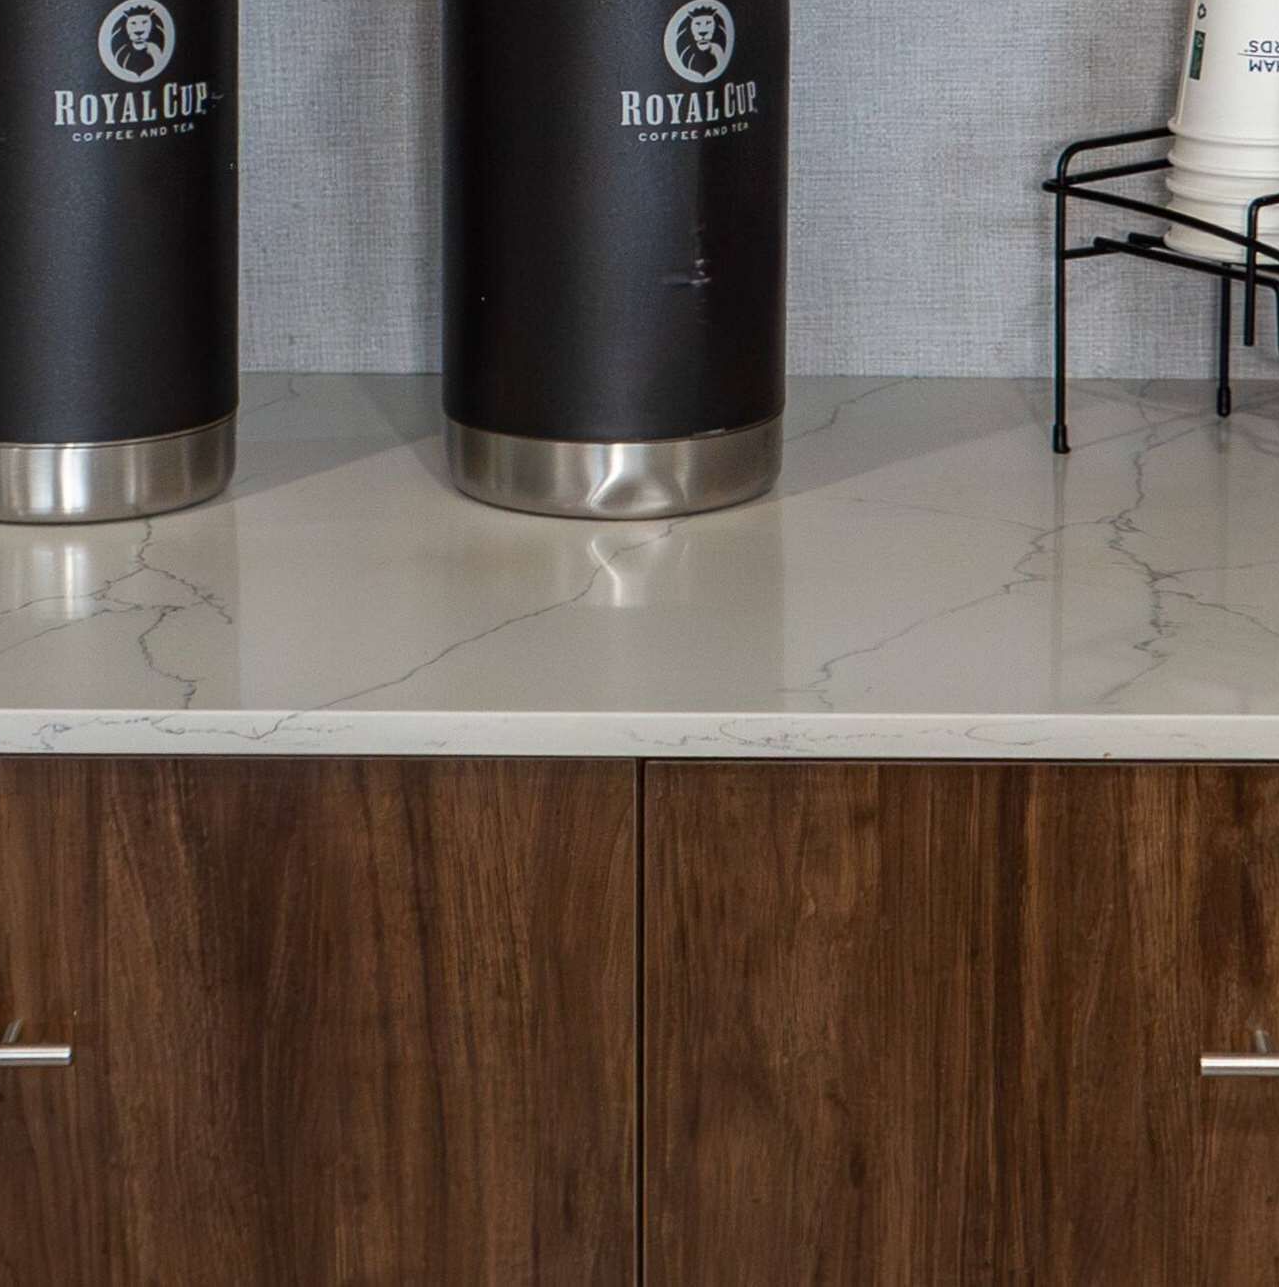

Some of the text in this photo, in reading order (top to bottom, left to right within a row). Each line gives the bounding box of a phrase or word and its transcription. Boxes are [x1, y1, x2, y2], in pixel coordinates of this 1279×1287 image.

[54, 90, 157, 126] ROYAL
[620, 90, 719, 126] ROYAL
[72, 122, 194, 142] COFFEE AND TEA
[638, 122, 749, 142] COFFEE AND TEA
